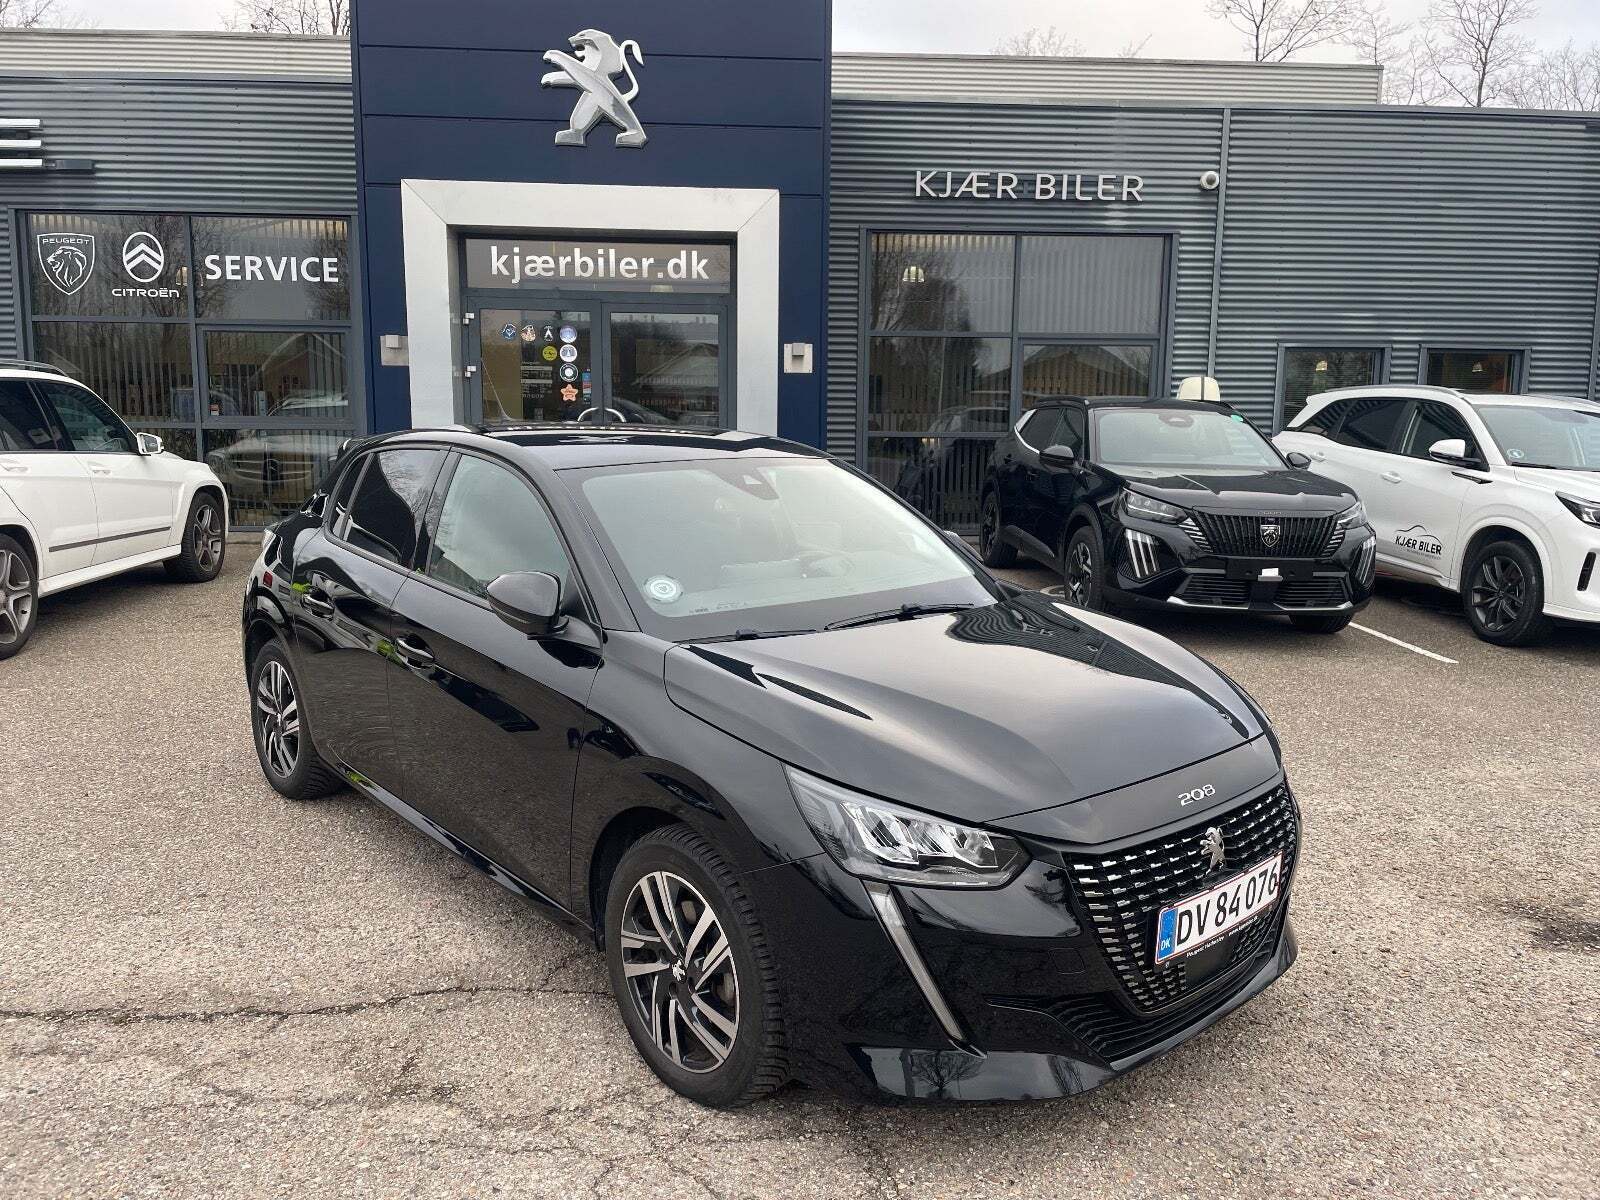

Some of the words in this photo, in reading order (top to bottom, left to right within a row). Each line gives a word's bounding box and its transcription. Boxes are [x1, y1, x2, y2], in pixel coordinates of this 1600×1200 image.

[915, 169, 1018, 199] KJÆR
[1035, 173, 1144, 201] BILER
[42, 237, 90, 245] PEUGEOT
[204, 254, 339, 283] SERVICE
[490, 245, 709, 284] kjærbiler.dk
[1395, 535, 1417, 550] KJÆR
[1418, 540, 1442, 556] BILER
[1178, 784, 1216, 806] 208
[1160, 937, 1171, 951] DK
